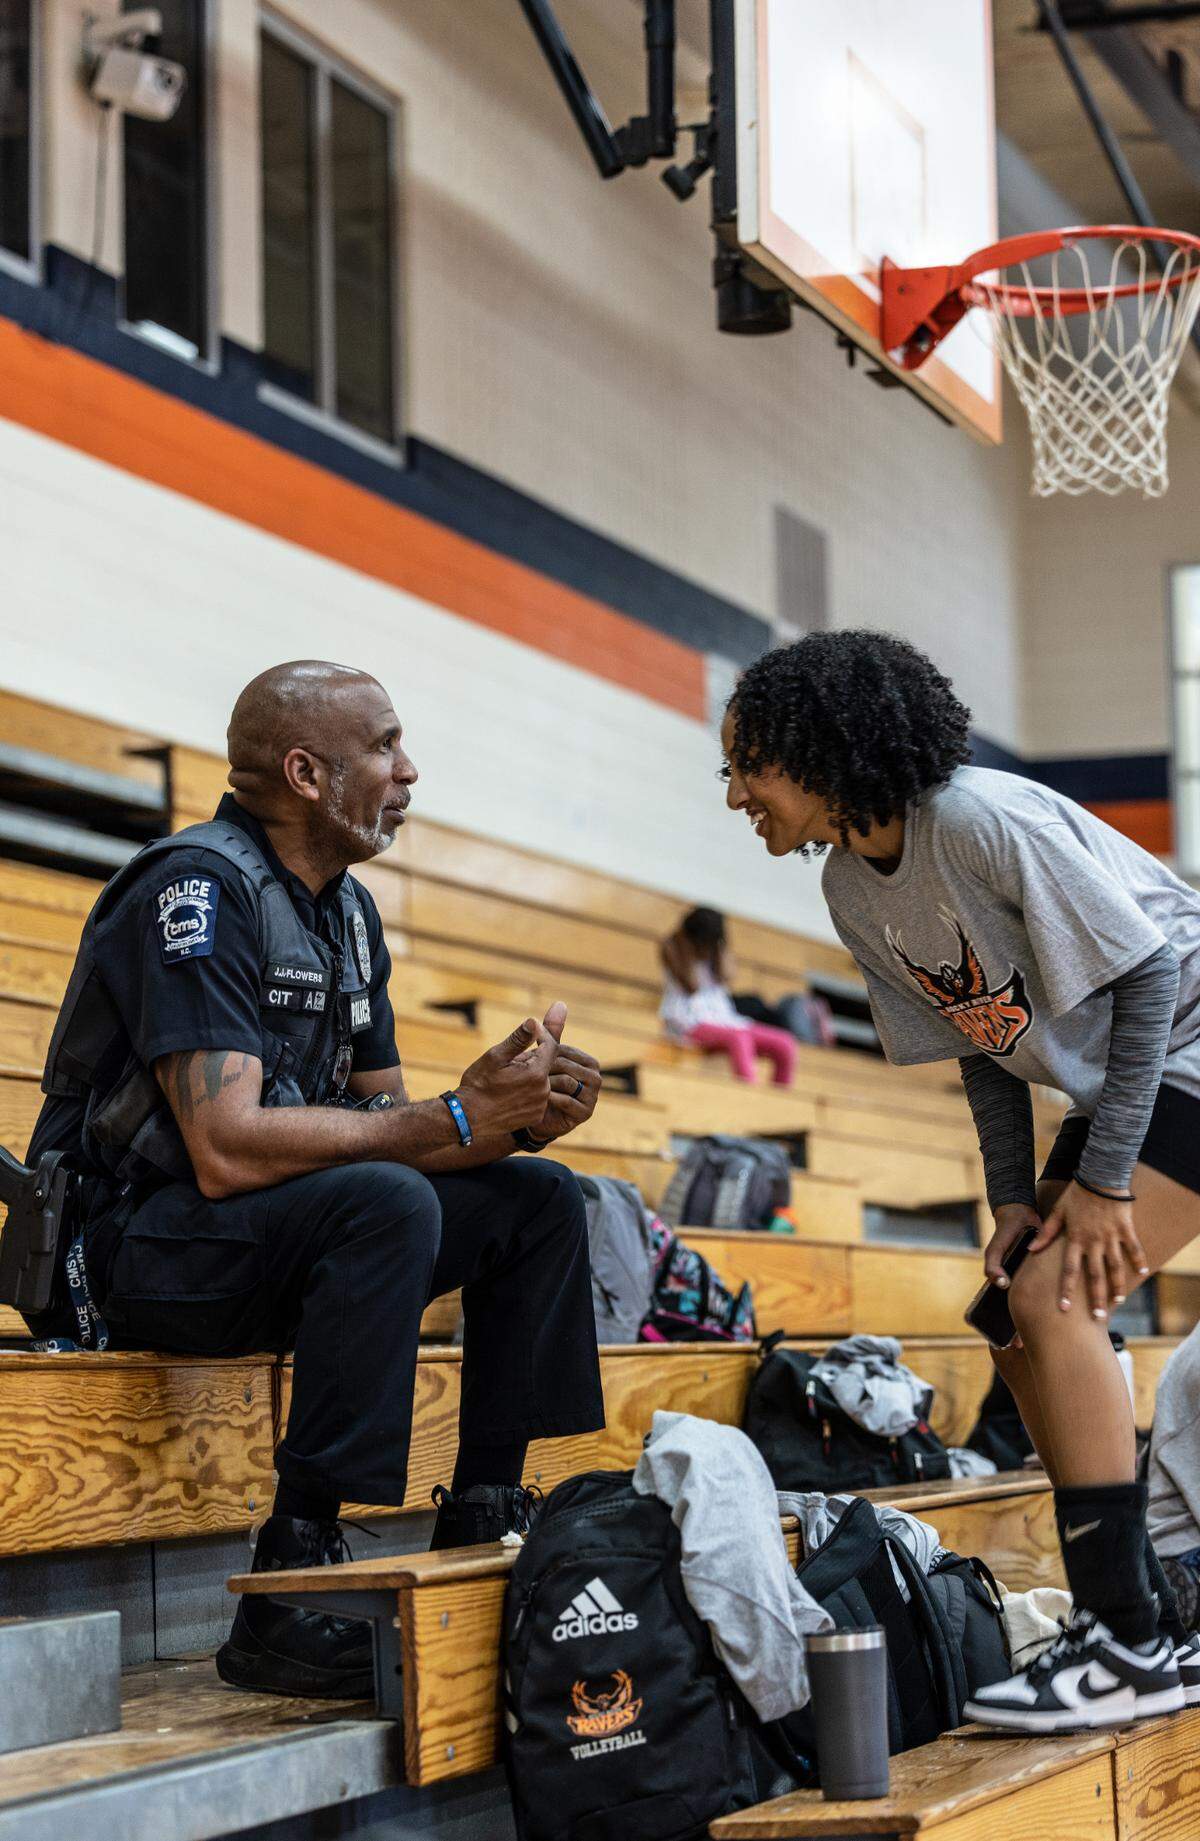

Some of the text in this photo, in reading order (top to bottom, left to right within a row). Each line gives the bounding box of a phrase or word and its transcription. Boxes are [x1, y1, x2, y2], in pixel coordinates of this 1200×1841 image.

[157, 879, 211, 910] POLICE
[168, 918, 200, 935] cms
[268, 989, 293, 1006] CIT
[66, 1259, 81, 1288] CMS
[76, 1305, 91, 1344] OLICE
[552, 1613, 639, 1642] adidas
[570, 1729, 647, 1760] VOLLEYBALL
